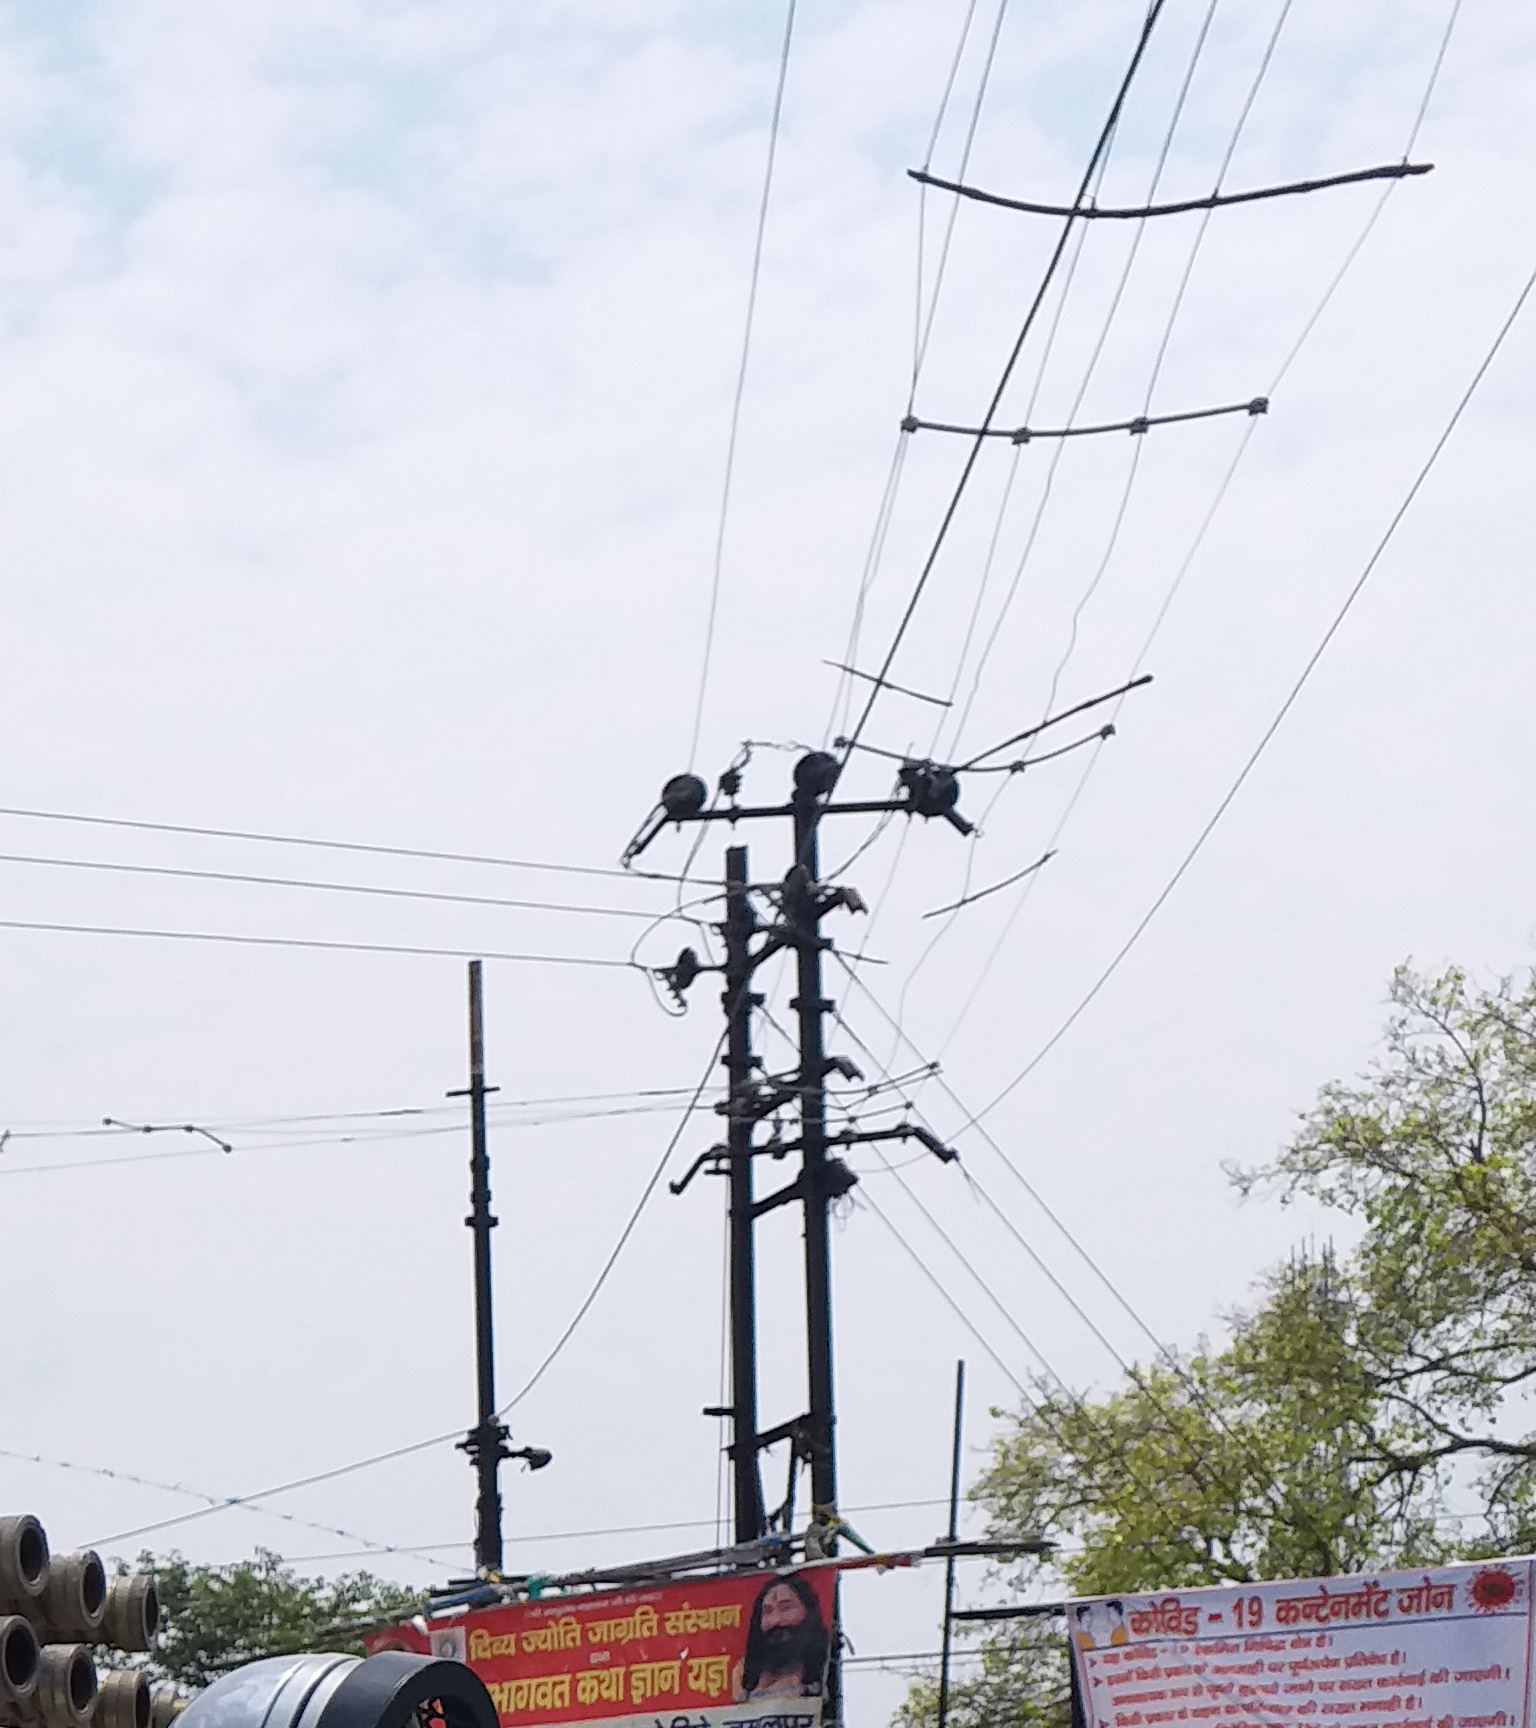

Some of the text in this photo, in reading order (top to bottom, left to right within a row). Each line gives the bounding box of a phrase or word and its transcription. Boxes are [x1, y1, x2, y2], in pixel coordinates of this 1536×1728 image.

[469, 1629, 516, 1661] दिव्य
[522, 1616, 581, 1653] ज्योति
[665, 1601, 742, 1636] संस्थान
[1129, 1598, 1202, 1636] कोविड
[1233, 1595, 1263, 1628] 19
[1396, 1576, 1458, 1614] जोन
[577, 1666, 626, 1704] कथा
[630, 1660, 681, 1705] ज्ञान
[687, 1655, 730, 1698] यज्ञ
